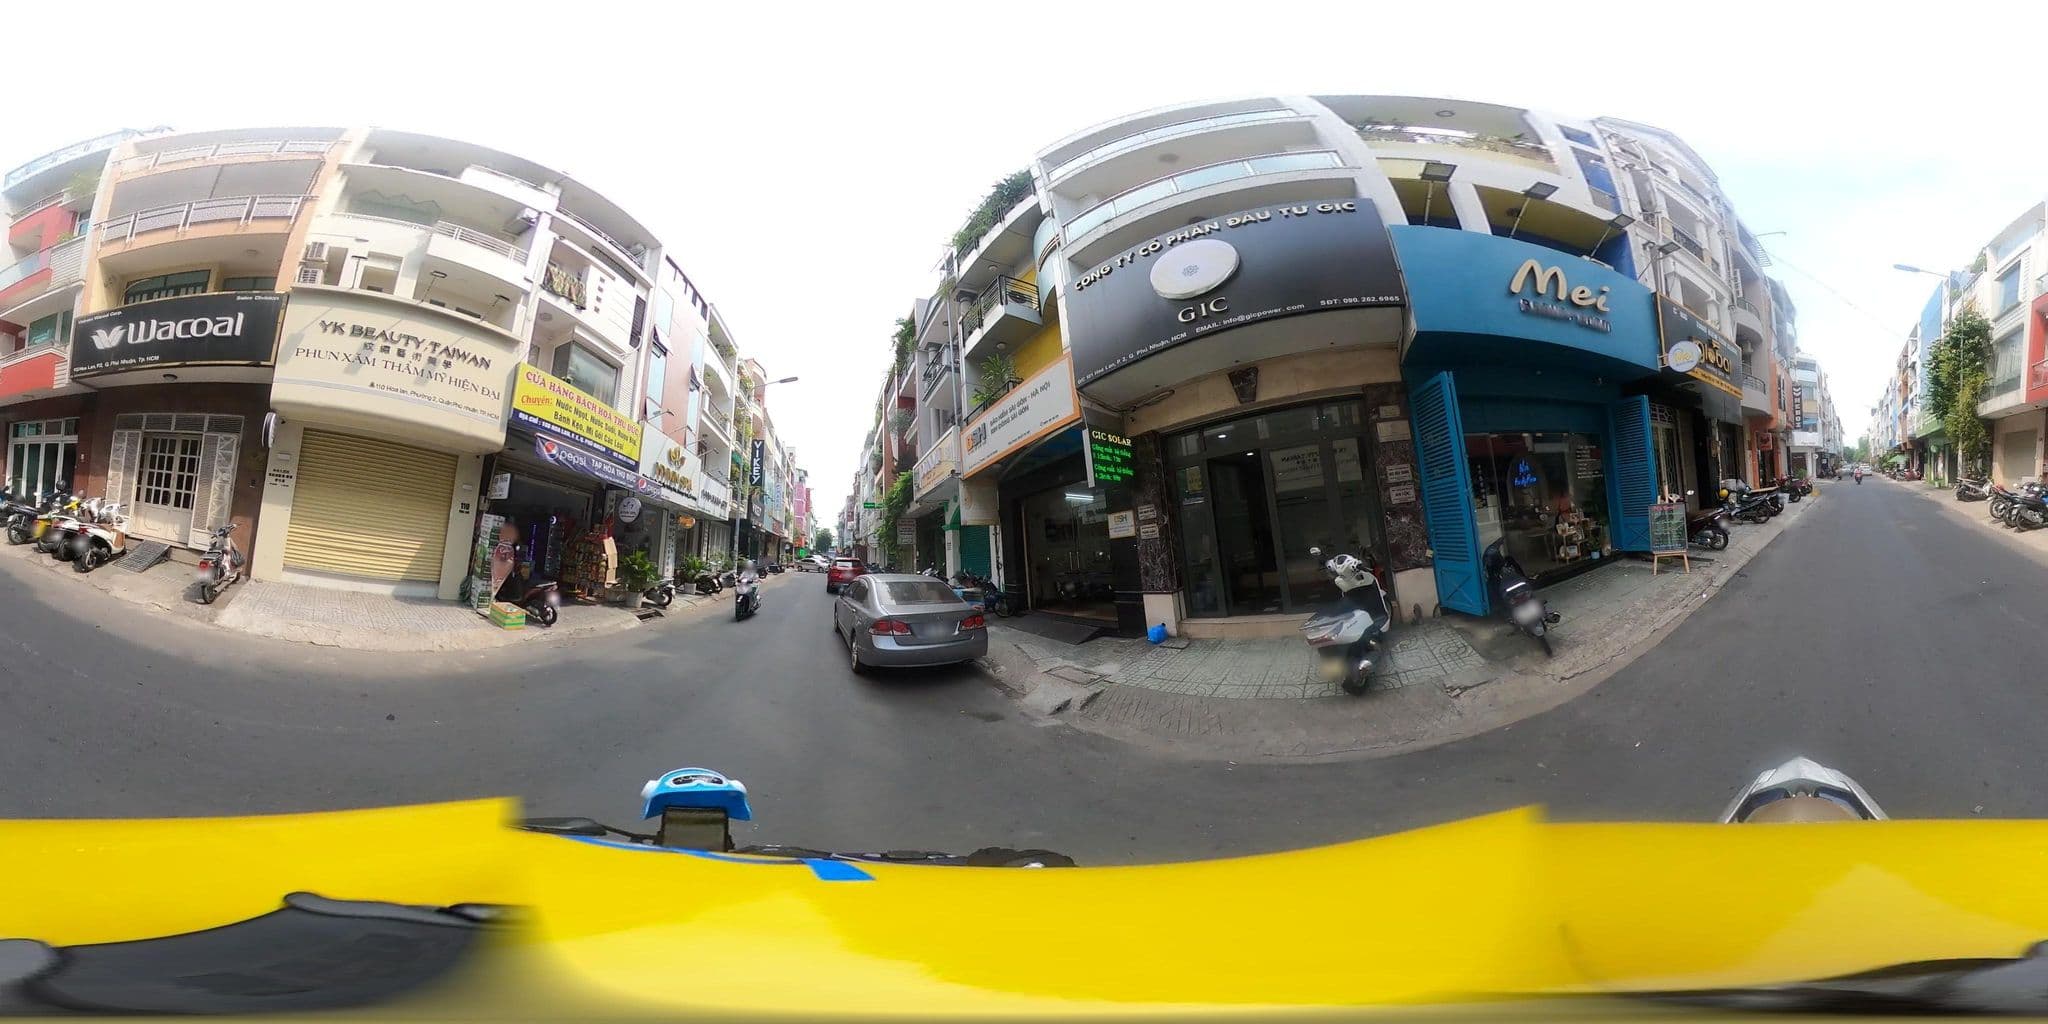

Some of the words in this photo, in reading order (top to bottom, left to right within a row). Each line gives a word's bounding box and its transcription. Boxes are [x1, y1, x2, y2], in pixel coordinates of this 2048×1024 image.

[1116, 252, 1135, 268] TY
[1316, 201, 1356, 213] GIC
[1510, 259, 1610, 312] Mei
[1178, 296, 1228, 322] GIC
[127, 312, 244, 344] Wacoal
[1171, 332, 1187, 342] HCM
[1196, 321, 1221, 333] EMAIL:
[296, 347, 340, 361] PHUN
[319, 320, 345, 336] YK
[428, 341, 491, 371] TAIWAN
[560, 449, 586, 466] pepsi
[751, 440, 762, 485] VIKEY
